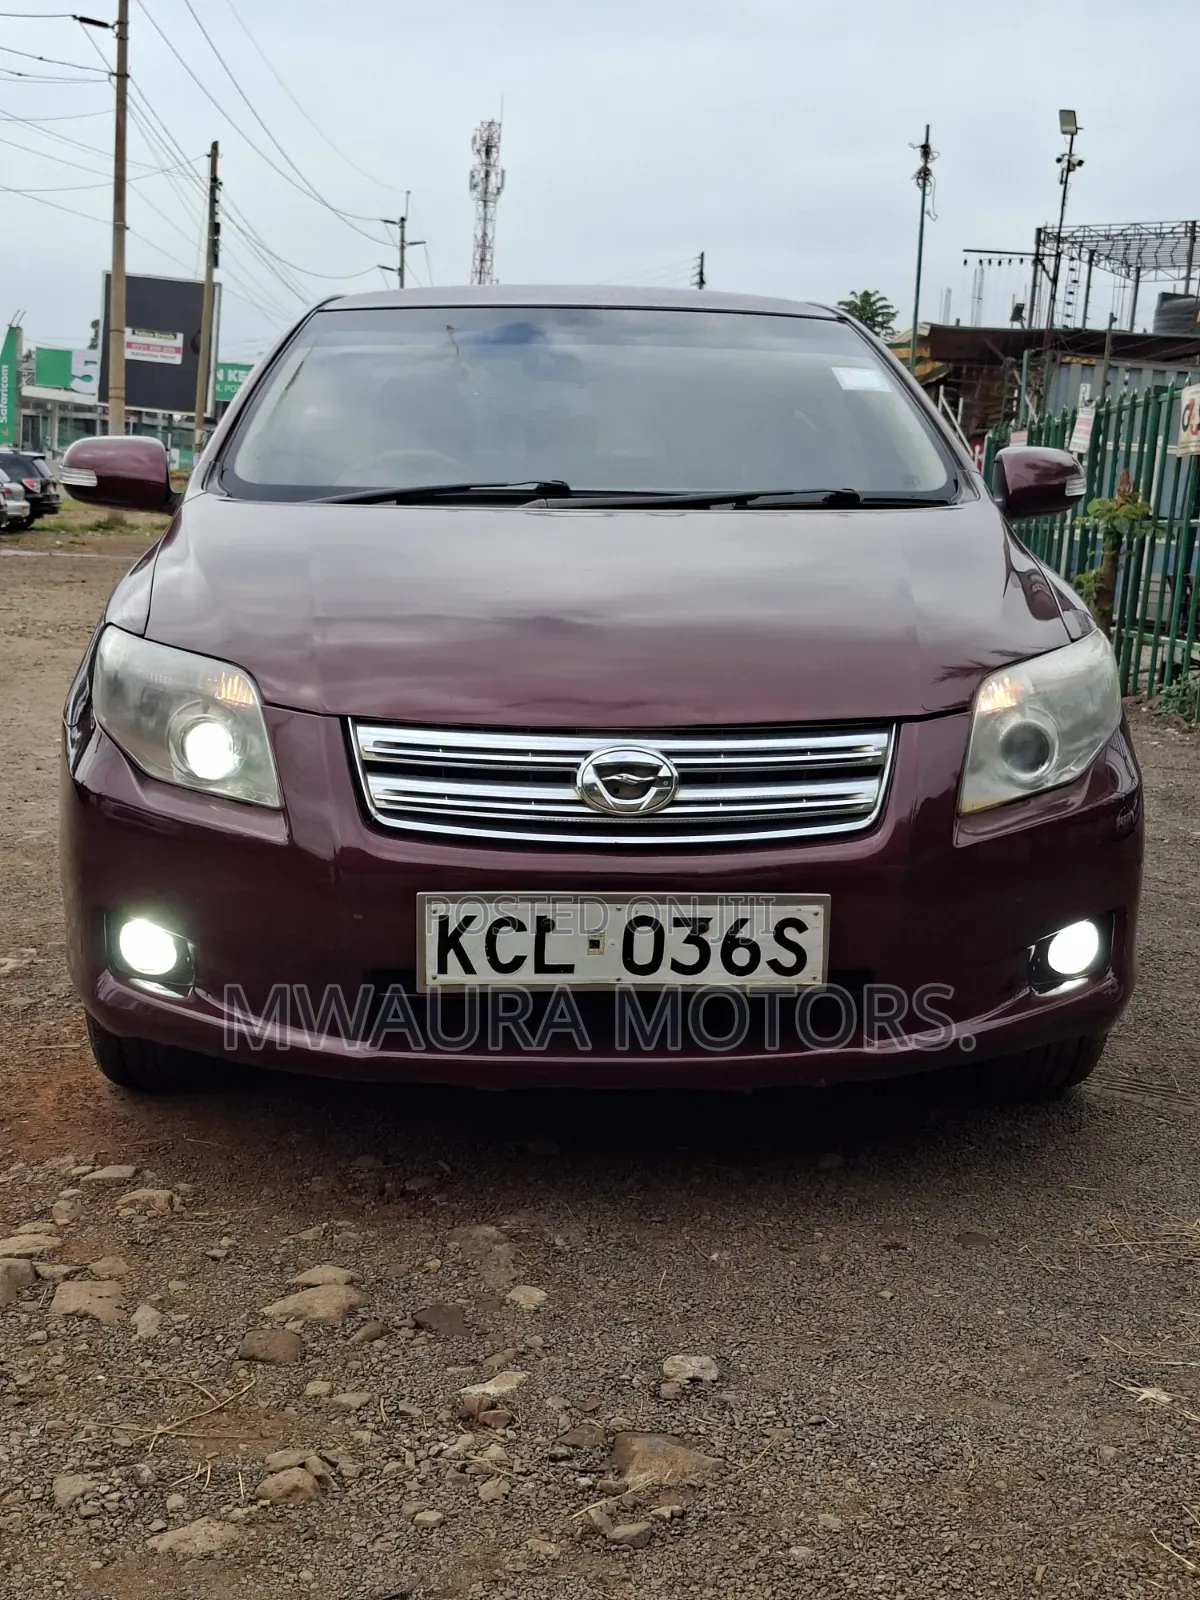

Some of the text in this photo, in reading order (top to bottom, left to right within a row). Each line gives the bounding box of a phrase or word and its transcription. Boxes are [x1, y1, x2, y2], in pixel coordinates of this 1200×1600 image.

[0, 364, 9, 424] Safaricom
[436, 914, 810, 977] KCL 036S
